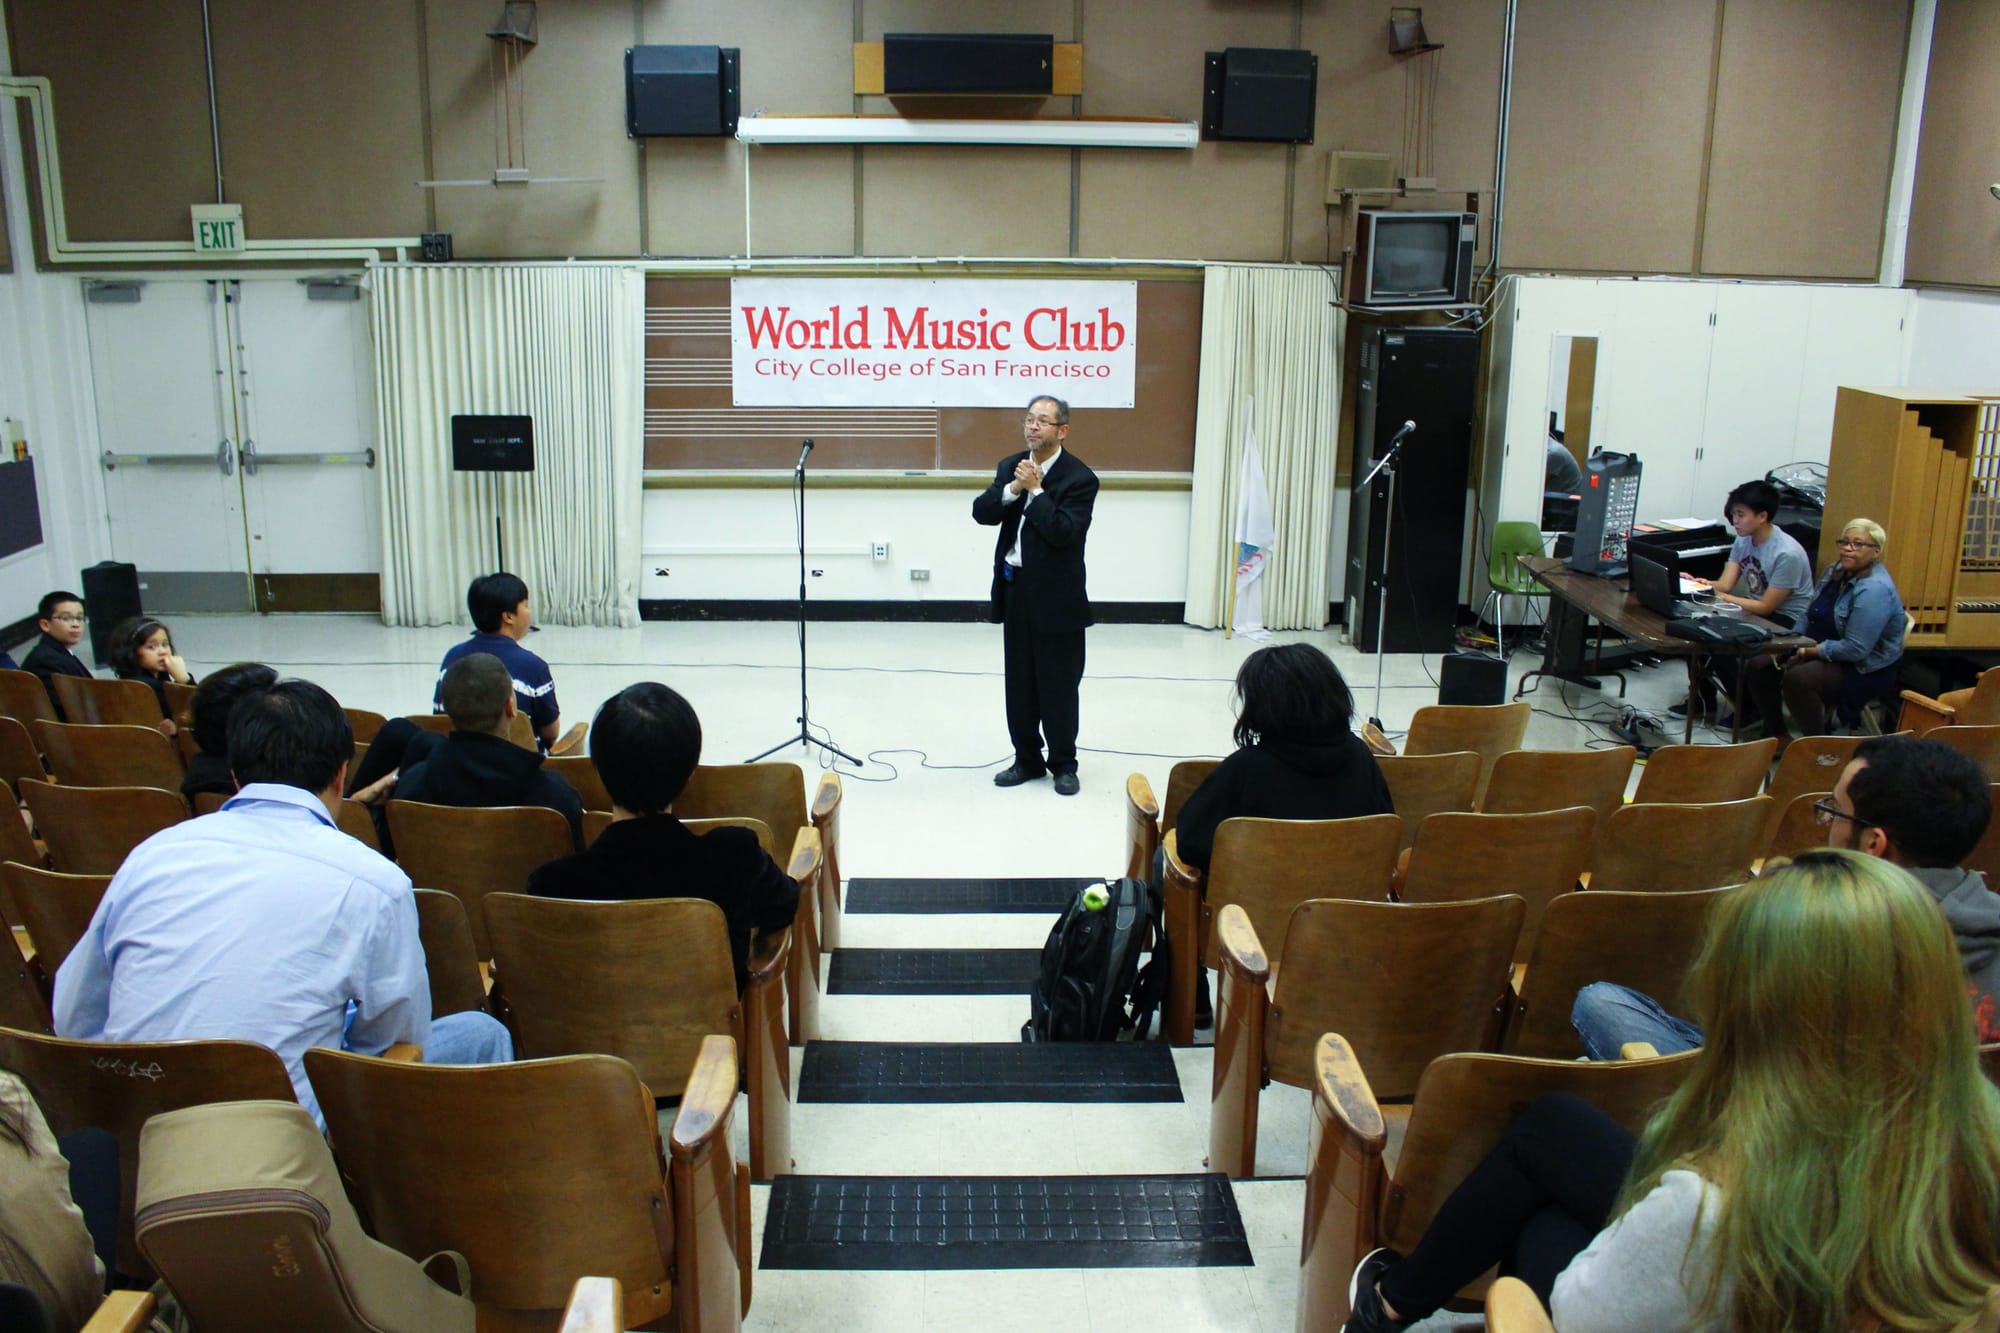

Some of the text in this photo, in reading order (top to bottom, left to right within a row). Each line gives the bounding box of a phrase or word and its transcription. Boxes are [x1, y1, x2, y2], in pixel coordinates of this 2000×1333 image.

[199, 221, 235, 249] EXIT
[741, 305, 1126, 352] World Music Club
[755, 358, 1111, 381] City College of San Francisco
